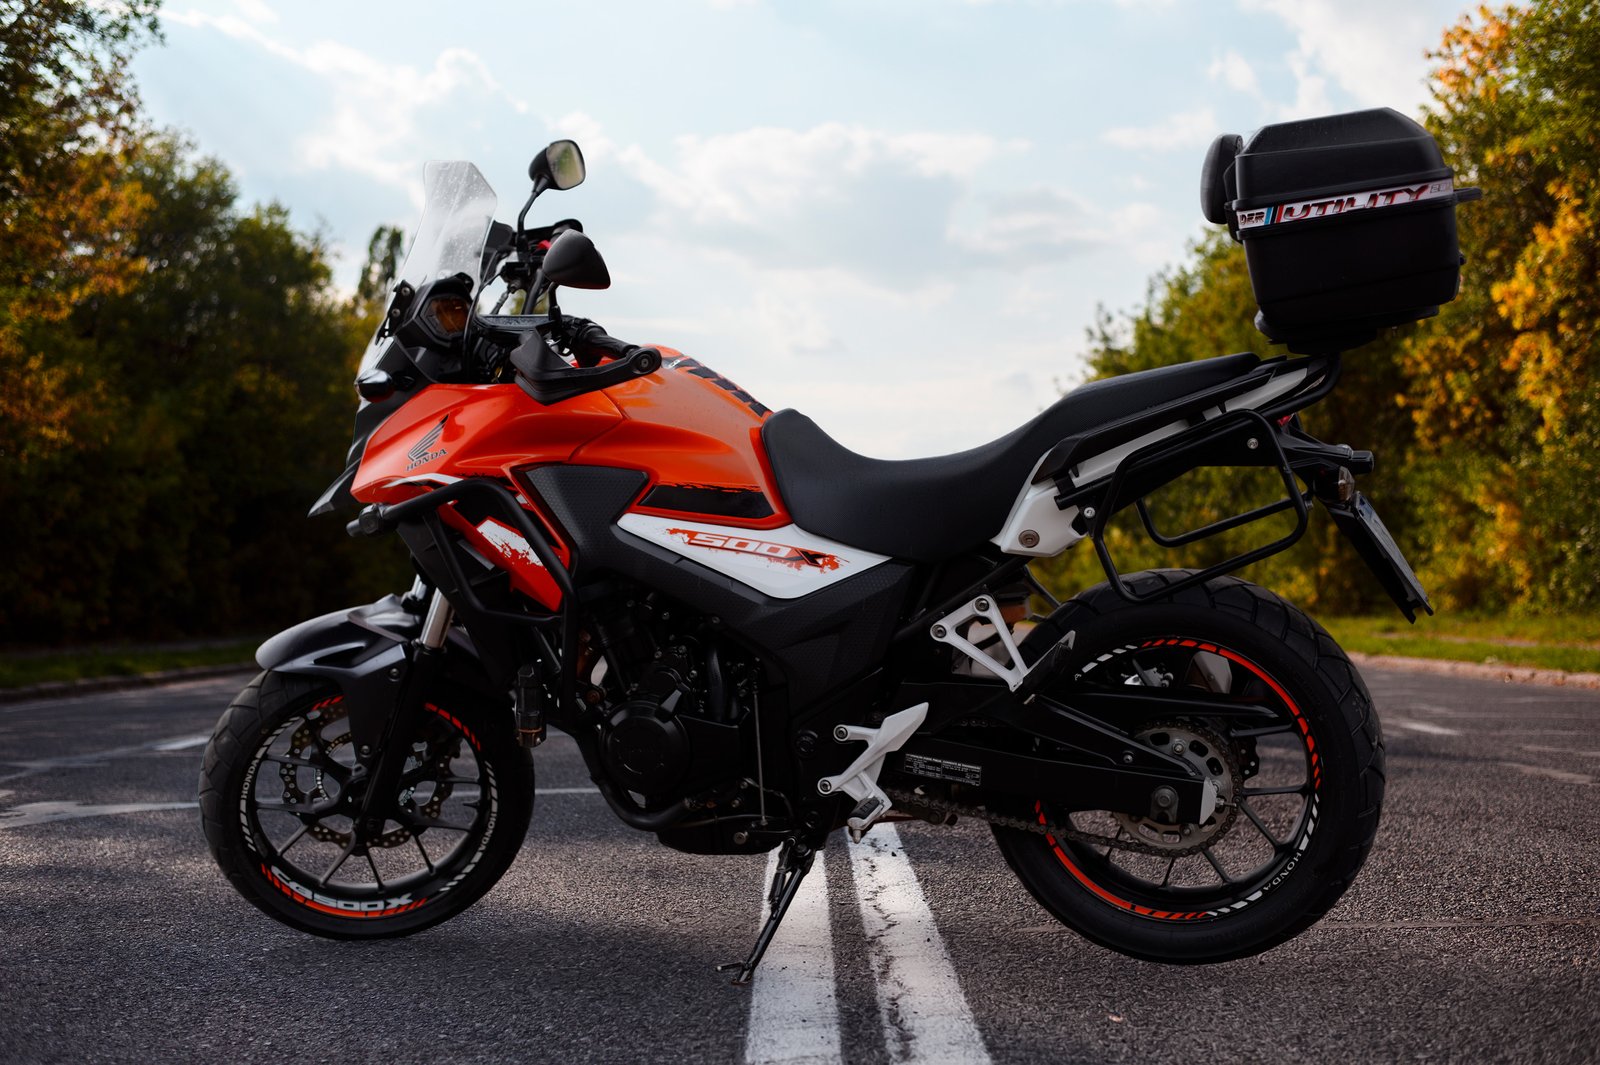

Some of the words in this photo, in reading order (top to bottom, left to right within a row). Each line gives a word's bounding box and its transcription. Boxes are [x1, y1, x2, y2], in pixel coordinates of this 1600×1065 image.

[1283, 184, 1430, 220] UTILITY
[405, 448, 448, 472] HONDA
[689, 532, 829, 568] 500X
[240, 759, 260, 799] HONDA
[478, 813, 497, 851] HONDA
[1262, 851, 1302, 890] HONDA
